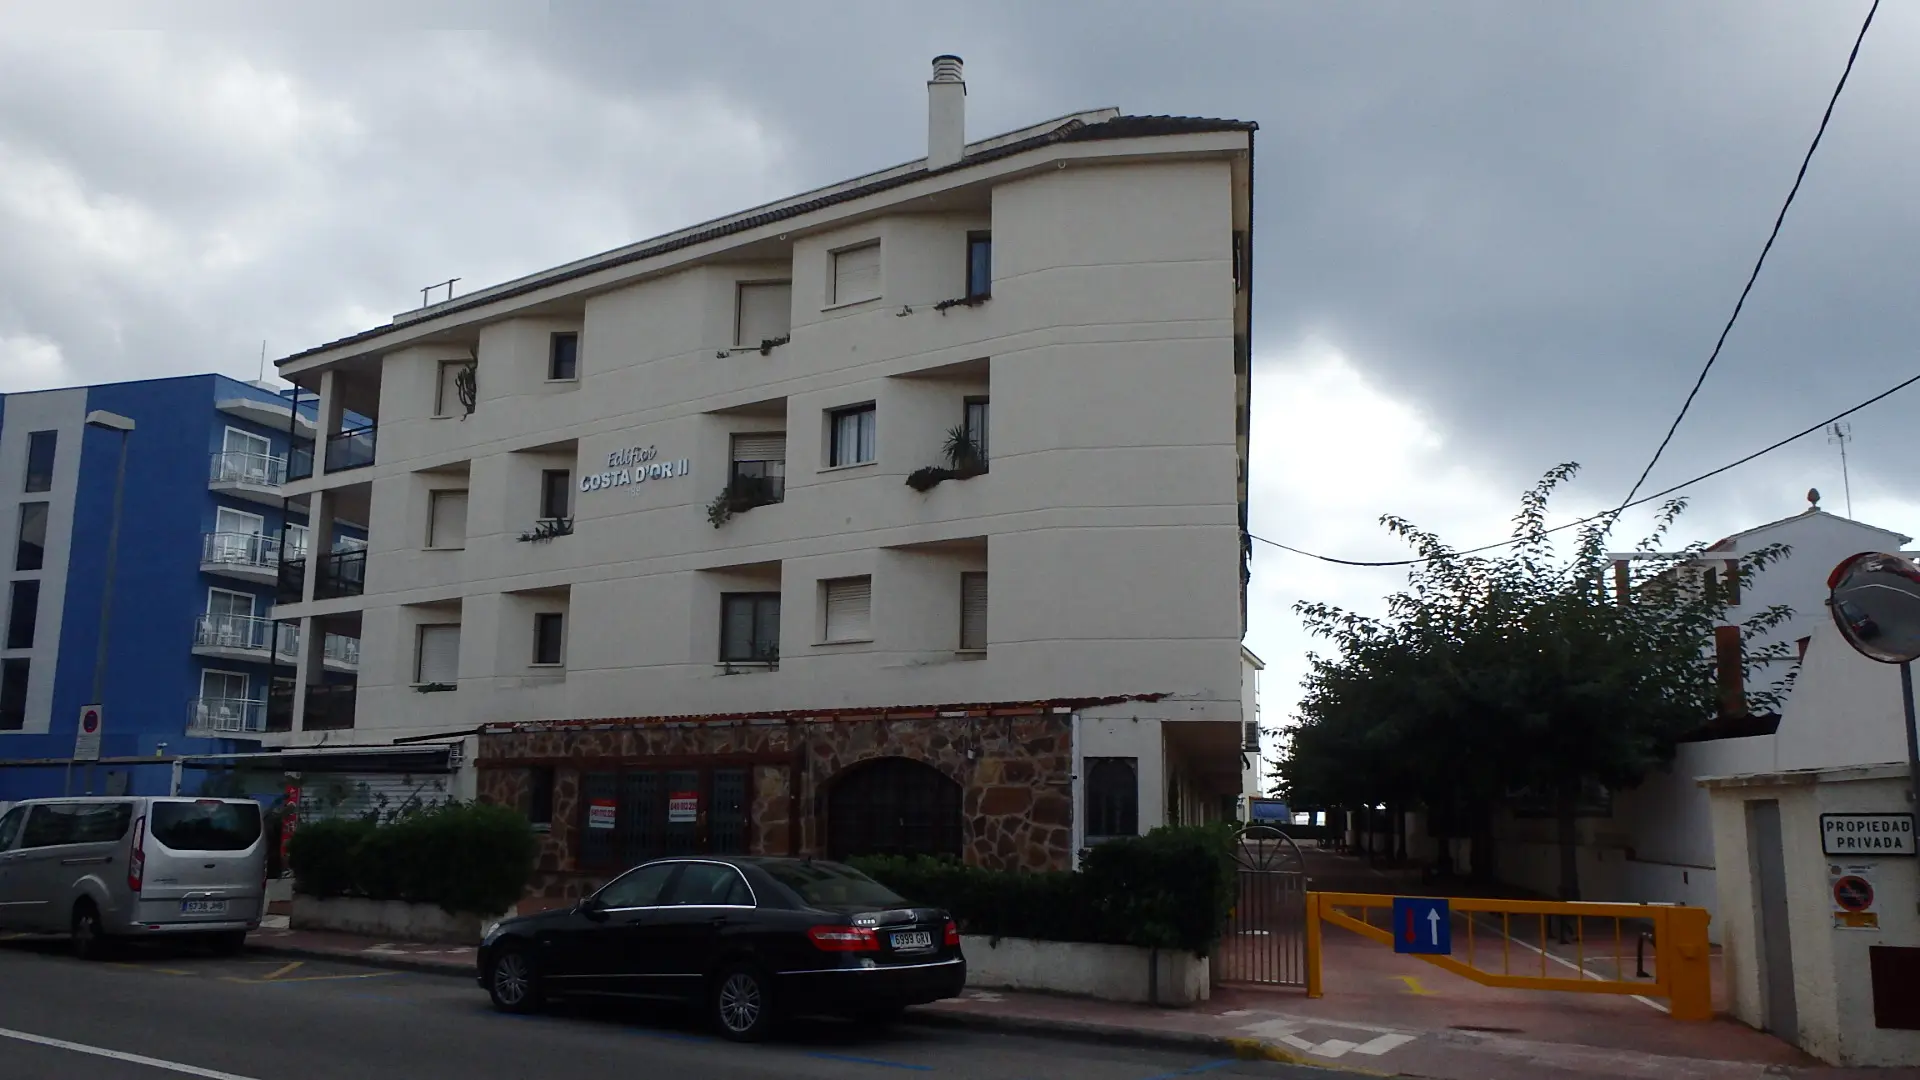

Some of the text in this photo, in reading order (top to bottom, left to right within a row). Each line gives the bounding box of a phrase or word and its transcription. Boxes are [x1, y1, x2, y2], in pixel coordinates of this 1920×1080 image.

[580, 458, 689, 492] COSTA D'OR II
[1826, 821, 1910, 832] PROPIEDAD
[1837, 837, 1902, 848] PRIVADA
[895, 934, 914, 945] 6999
